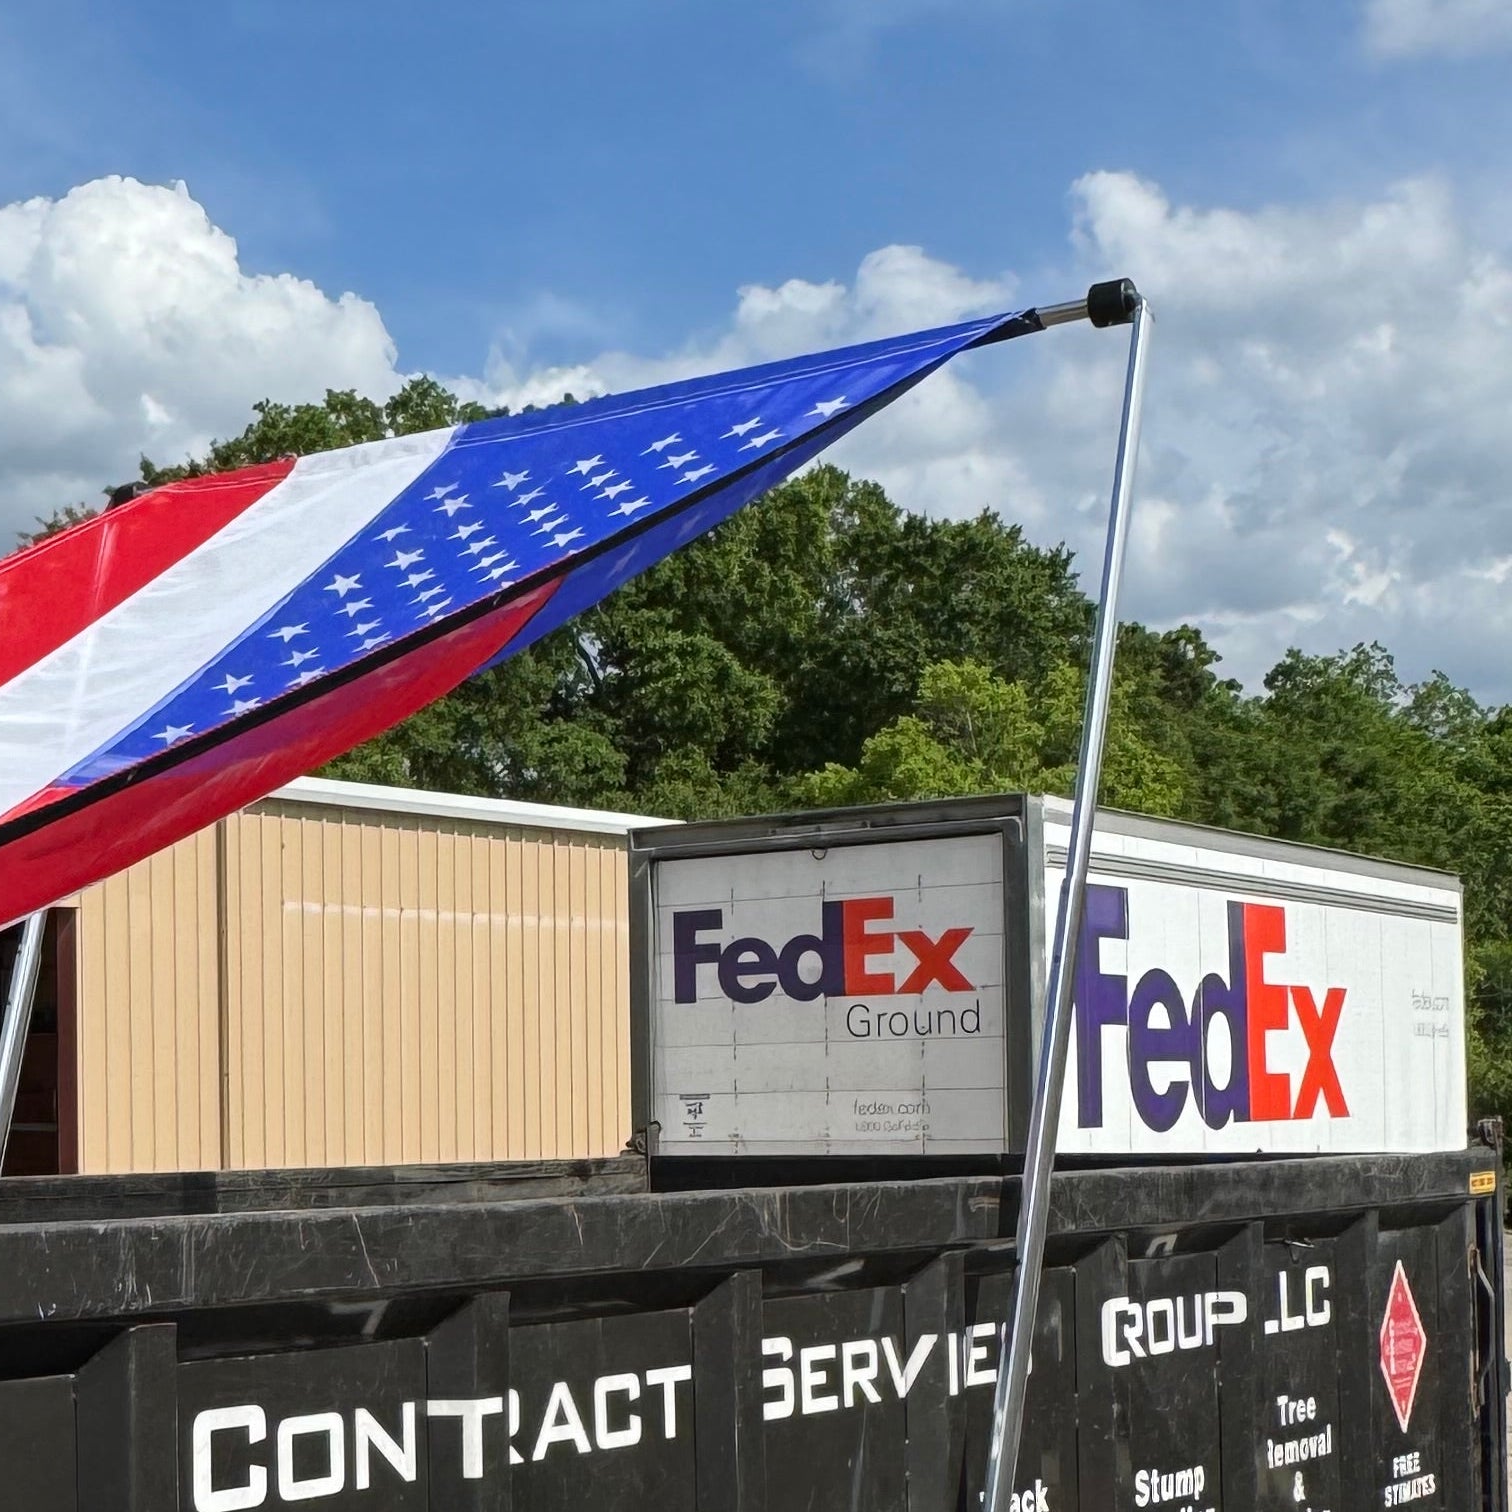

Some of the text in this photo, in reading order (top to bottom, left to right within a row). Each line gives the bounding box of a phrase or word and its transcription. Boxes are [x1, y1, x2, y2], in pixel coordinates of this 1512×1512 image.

[673, 896, 976, 1003] FedEx
[846, 1000, 981, 1039] Ground
[1074, 883, 1351, 1133] FedEx
[1277, 1395, 1316, 1426] Tree
[1135, 1465, 1205, 1507] Stump
[1293, 1471, 1306, 1502] &
[1385, 1473, 1436, 1507] STIMATES
